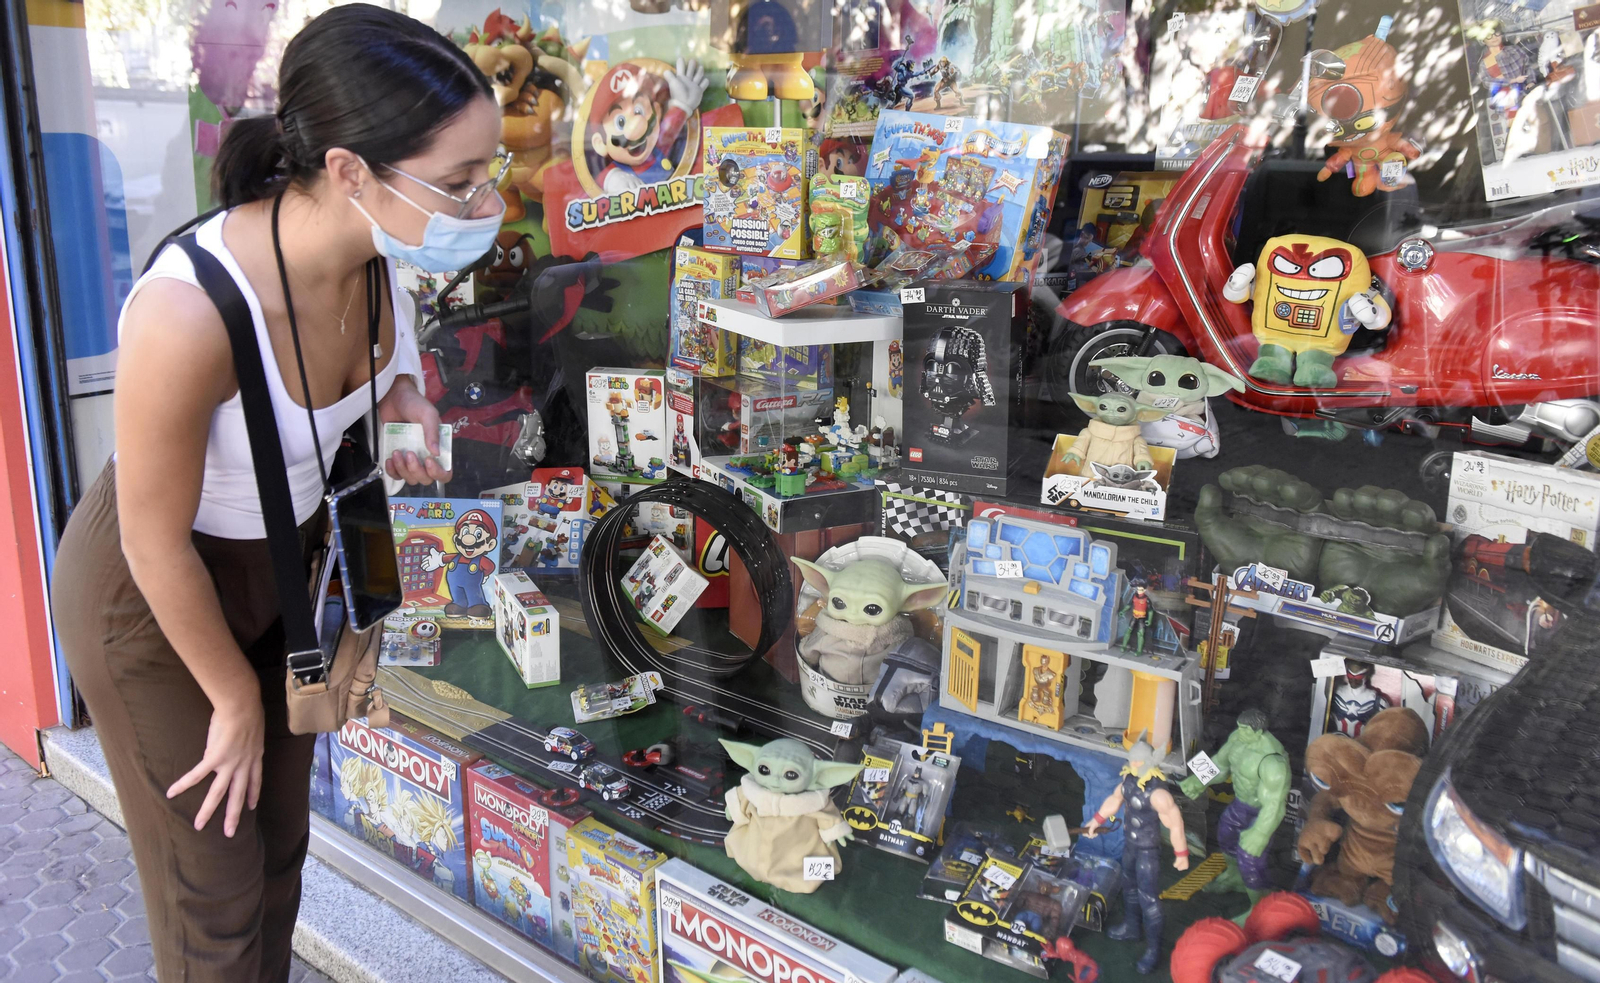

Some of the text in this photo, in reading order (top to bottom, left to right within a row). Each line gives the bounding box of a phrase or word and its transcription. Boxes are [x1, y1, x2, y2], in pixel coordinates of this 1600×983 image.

[1161, 159, 1183, 169] TITAN
[1089, 174, 1112, 187] NERF
[568, 191, 636, 230] SUPER
[732, 218, 767, 230] MISSION
[730, 228, 769, 240] POSSIBLE
[680, 281, 694, 289] JUEGO
[926, 305, 954, 315] DARTH
[1492, 363, 1542, 380] Vespa
[909, 450, 922, 459] LEGO
[971, 462, 999, 471] WARS
[920, 475, 936, 484] 75304
[1453, 479, 1488, 492] WIZARDING
[1083, 490, 1159, 507] MANDALORIAN THE CHILD
[1456, 486, 1484, 499] WORLD
[1504, 479, 1580, 513] Harry Potter
[421, 501, 452, 510] SUPER
[416, 509, 455, 520] MARIO
[1321, 612, 1338, 620] HULK
[1460, 638, 1496, 658] HOGWARTS
[341, 724, 449, 793] MONOPOLY
[477, 789, 540, 833] MONOPOLY
[480, 817, 521, 859] SUPER
[879, 833, 905, 847] BATMAN
[759, 910, 834, 951] MONOPOLY
[1331, 913, 1362, 940] E.T.
